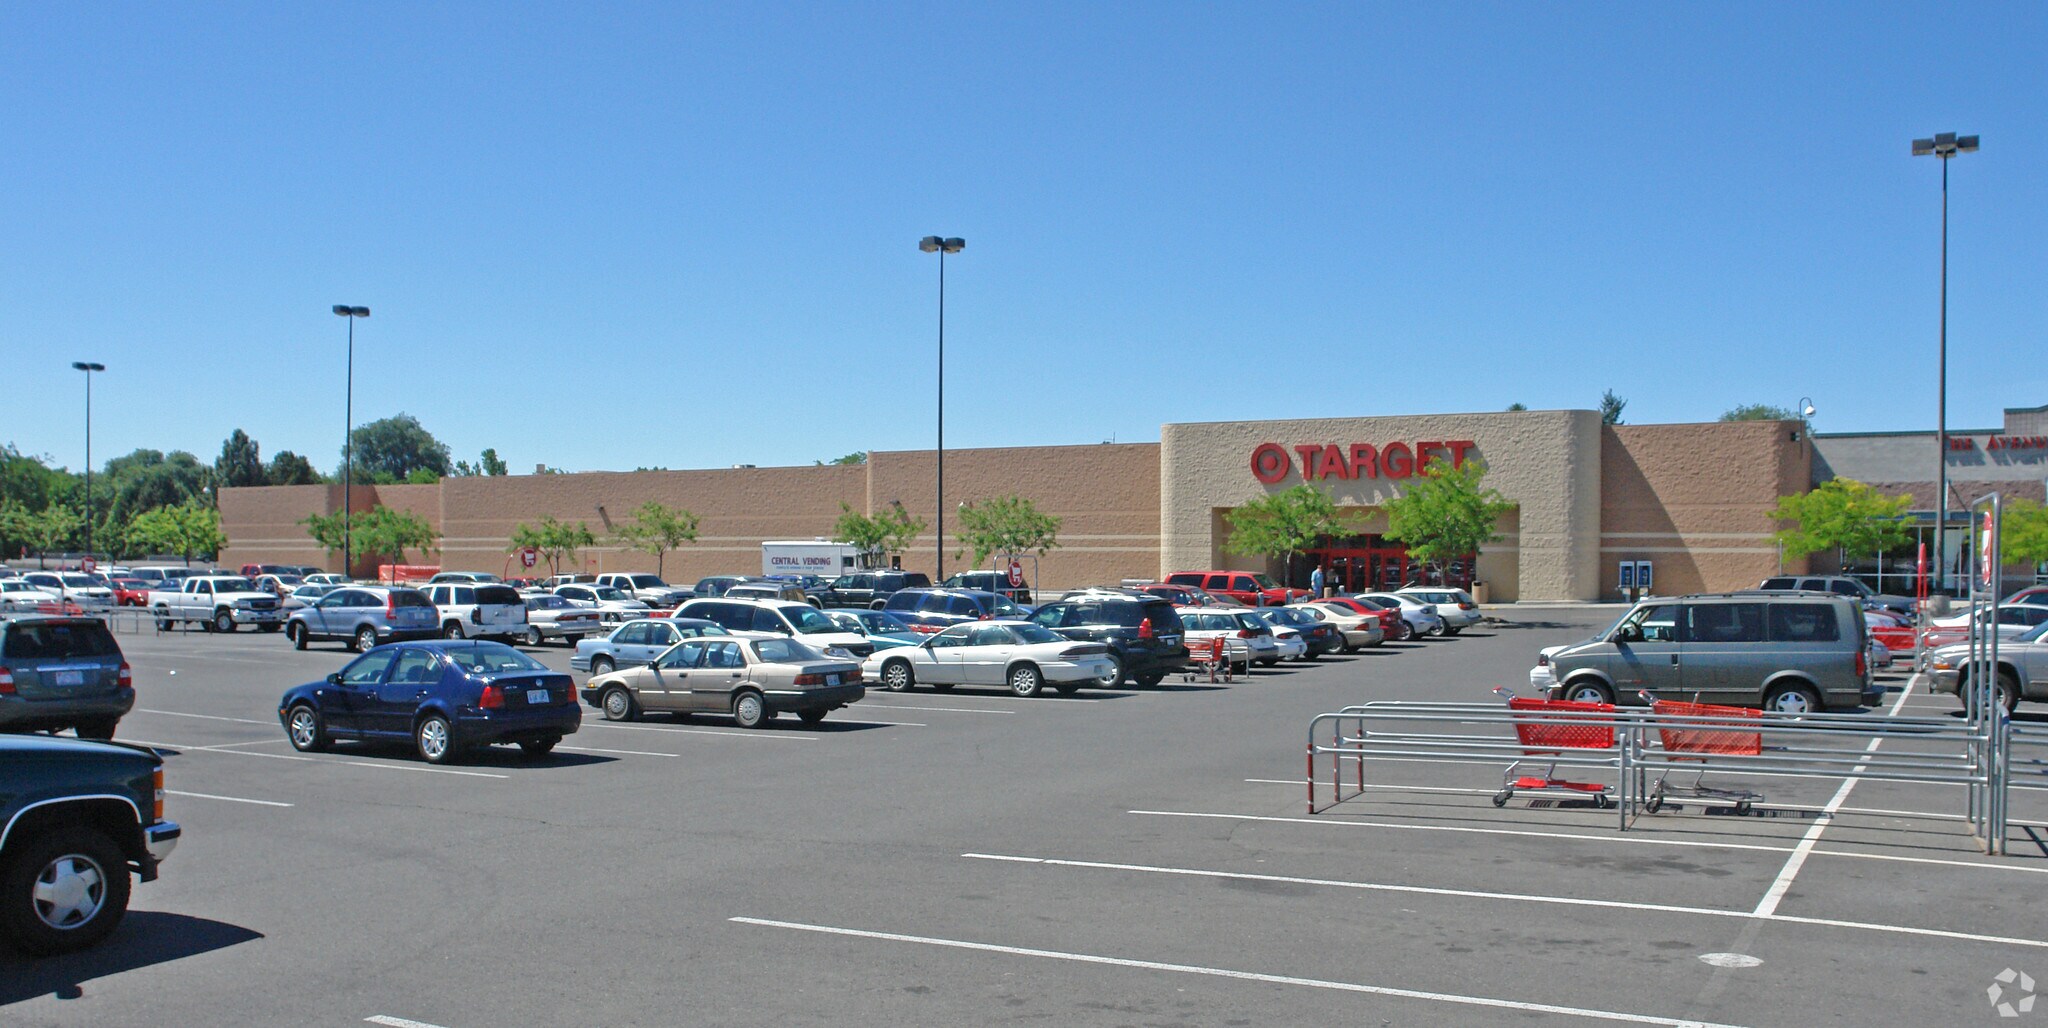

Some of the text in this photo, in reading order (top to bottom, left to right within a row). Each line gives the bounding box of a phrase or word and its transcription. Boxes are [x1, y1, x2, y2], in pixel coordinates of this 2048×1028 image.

[1294, 440, 1474, 481] TARGET
[771, 557, 831, 565] CENTRAL VENDING
